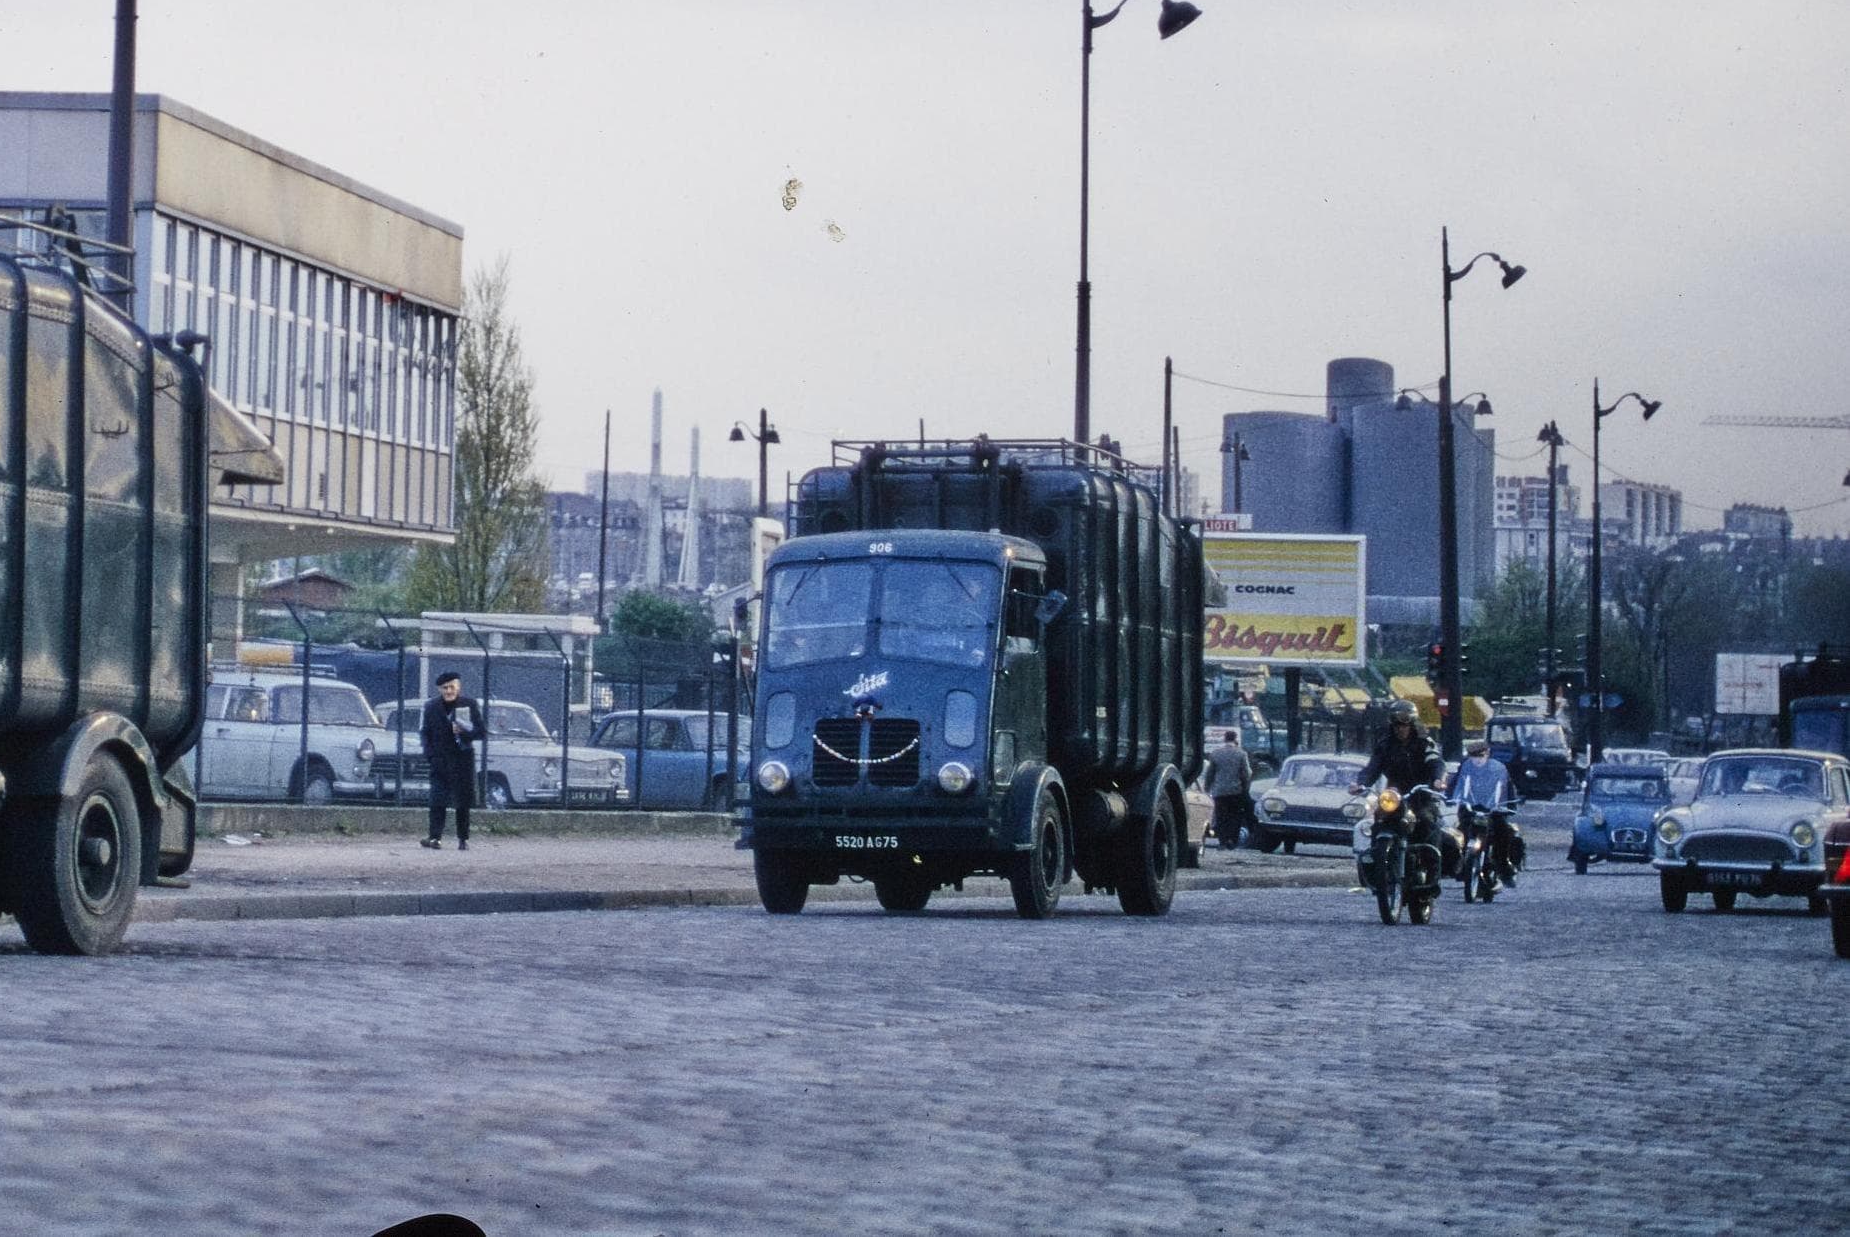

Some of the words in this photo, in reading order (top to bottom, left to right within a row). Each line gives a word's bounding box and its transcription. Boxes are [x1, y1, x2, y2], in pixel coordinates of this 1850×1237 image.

[869, 542, 892, 553] 906
[1235, 585, 1295, 594] COGNAC
[1204, 614, 1353, 657] Bisquit
[835, 835, 864, 848] 5520
